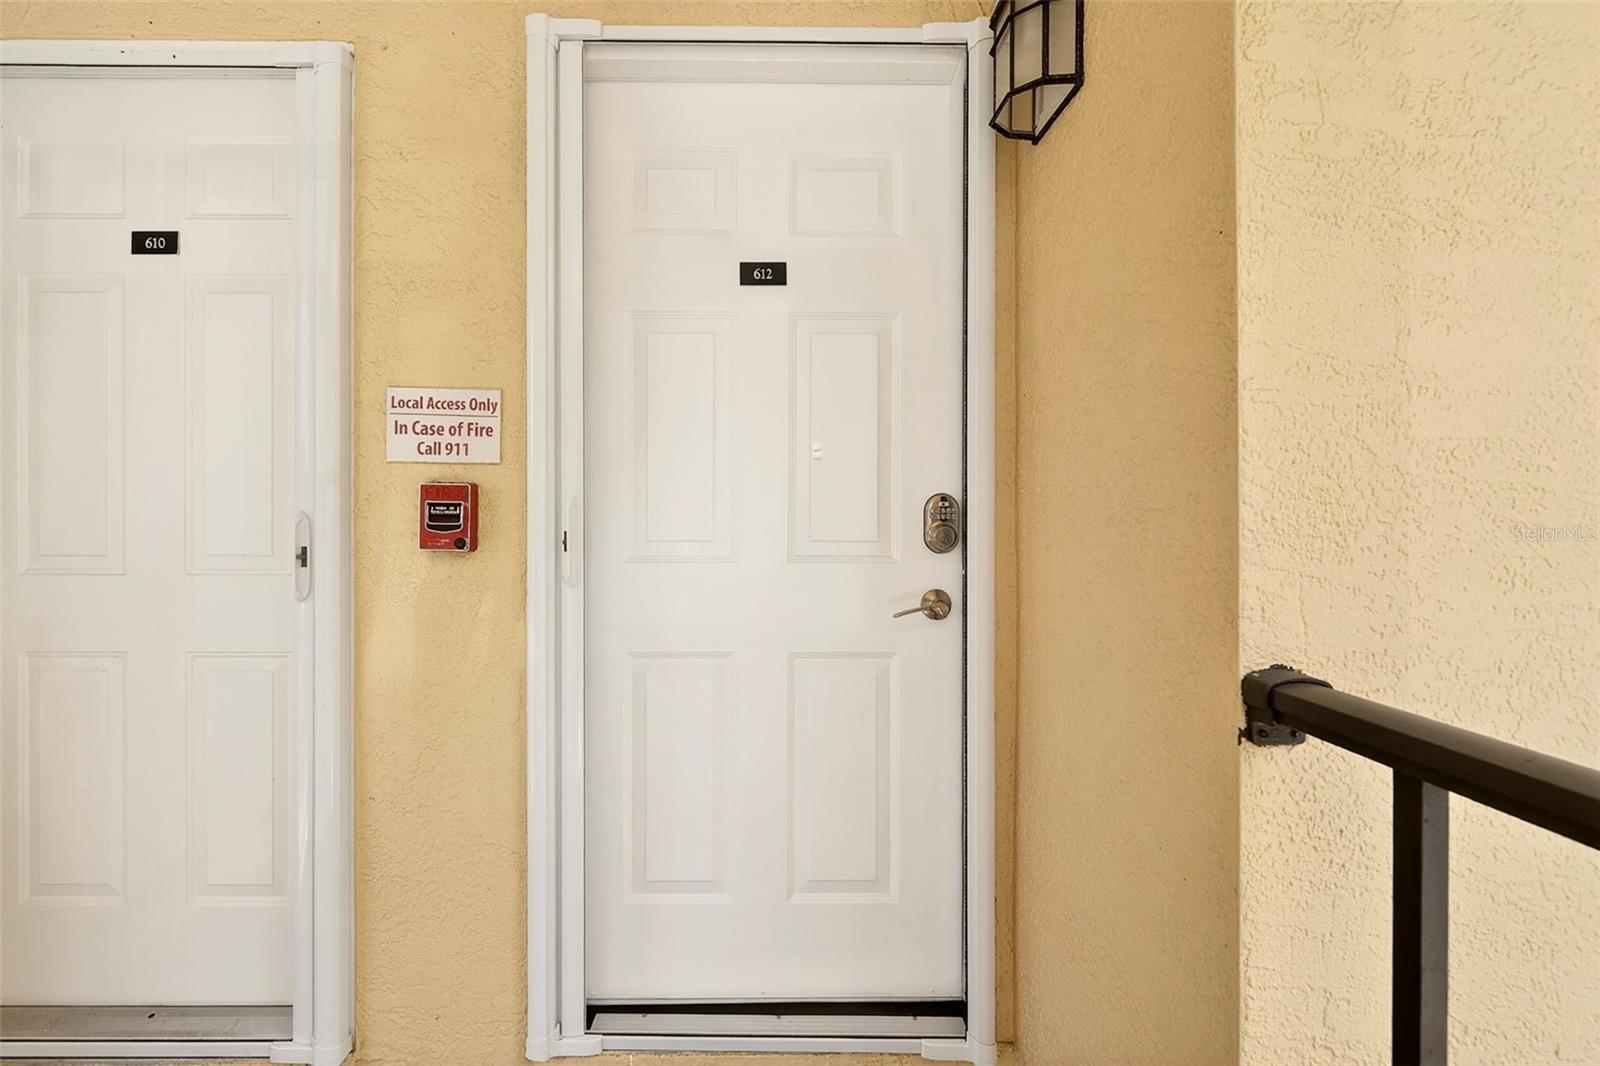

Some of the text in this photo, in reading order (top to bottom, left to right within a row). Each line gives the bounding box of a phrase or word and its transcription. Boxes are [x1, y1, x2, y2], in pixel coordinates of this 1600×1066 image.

[145, 237, 166, 249] 610
[753, 268, 773, 280] 612
[391, 396, 498, 414] Local Access Only
[394, 420, 493, 437] In Case of Fire
[417, 442, 469, 456] Call 911
